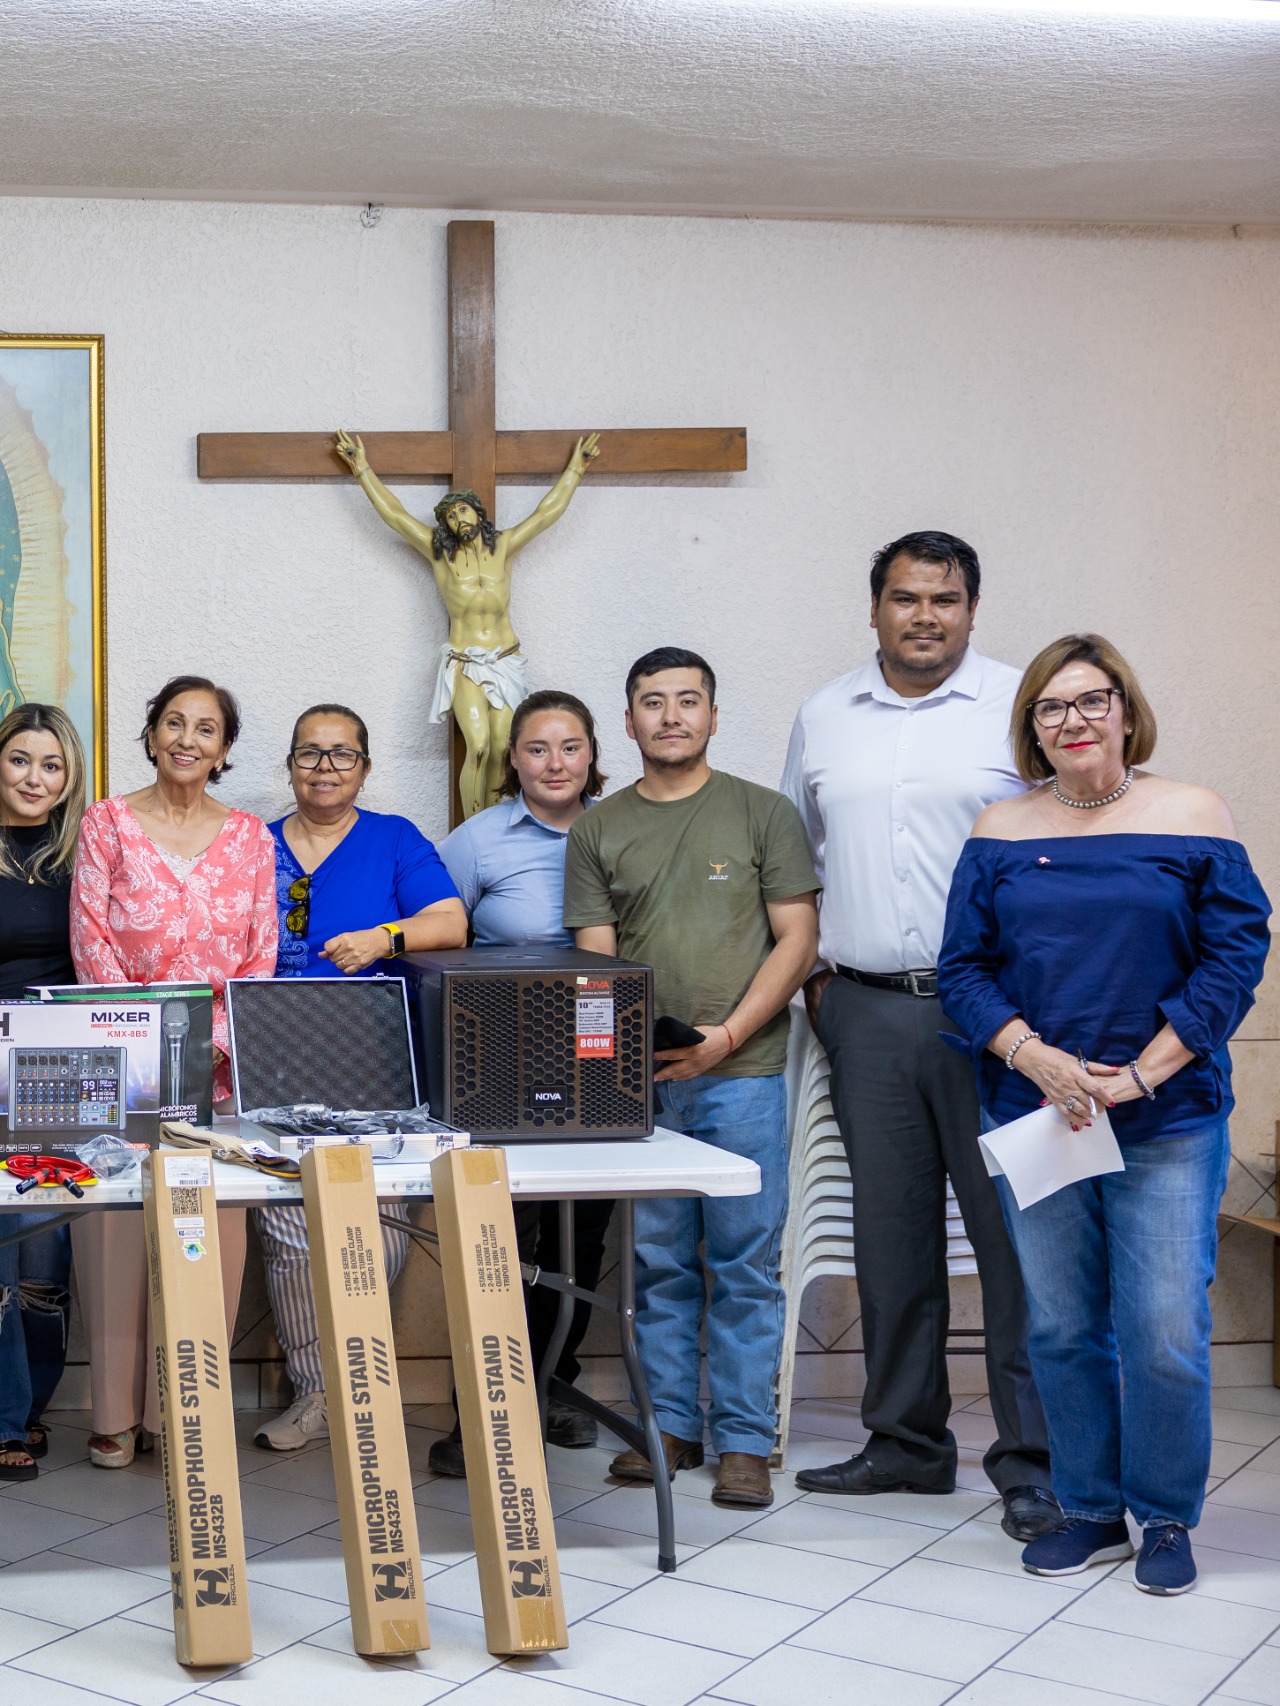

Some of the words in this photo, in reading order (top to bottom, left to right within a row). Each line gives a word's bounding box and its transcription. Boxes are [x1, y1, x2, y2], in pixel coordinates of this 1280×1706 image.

[580, 981, 610, 990] NOVA
[91, 1012, 150, 1022] MIXER
[107, 1030, 148, 1038] KMX-8BS
[580, 1038, 610, 1048] 800W
[535, 1093, 562, 1101] NOVA
[347, 1226, 355, 1248] CLAMP
[355, 1226, 363, 1251] CLUTCH
[481, 1224, 489, 1245] CLAMP
[489, 1224, 497, 1248] CLUTCH
[341, 1247, 349, 1269] SERIES
[350, 1250, 358, 1269] BOOM
[358, 1252, 366, 1270] TURN
[365, 1249, 374, 1265] LEGS
[475, 1244, 483, 1266] SERIES
[492, 1249, 500, 1267] TURN
[500, 1246, 508, 1262] LEGS
[344, 1271, 352, 1291] STAGE
[352, 1271, 360, 1291] 2-IN-1
[368, 1266, 376, 1290] TRIPOD
[478, 1266, 486, 1287] STAGE
[486, 1267, 494, 1287] 2-IN-1
[494, 1267, 502, 1287] QUICK
[502, 1264, 510, 1287] TRIPOD
[177, 1340, 199, 1408] STAND
[346, 1337, 371, 1405] STAND
[482, 1335, 506, 1402] STAND
[182, 1415, 211, 1559] MICROPHONE
[354, 1411, 388, 1554] MICROPHONE
[490, 1409, 524, 1551] MICROPHONE
[210, 1494, 227, 1559] MS432B
[385, 1489, 404, 1553] MS432B
[521, 1487, 540, 1550] MS432B
[407, 1559, 416, 1599] HERCULES
[543, 1556, 552, 1597] HERCULES
